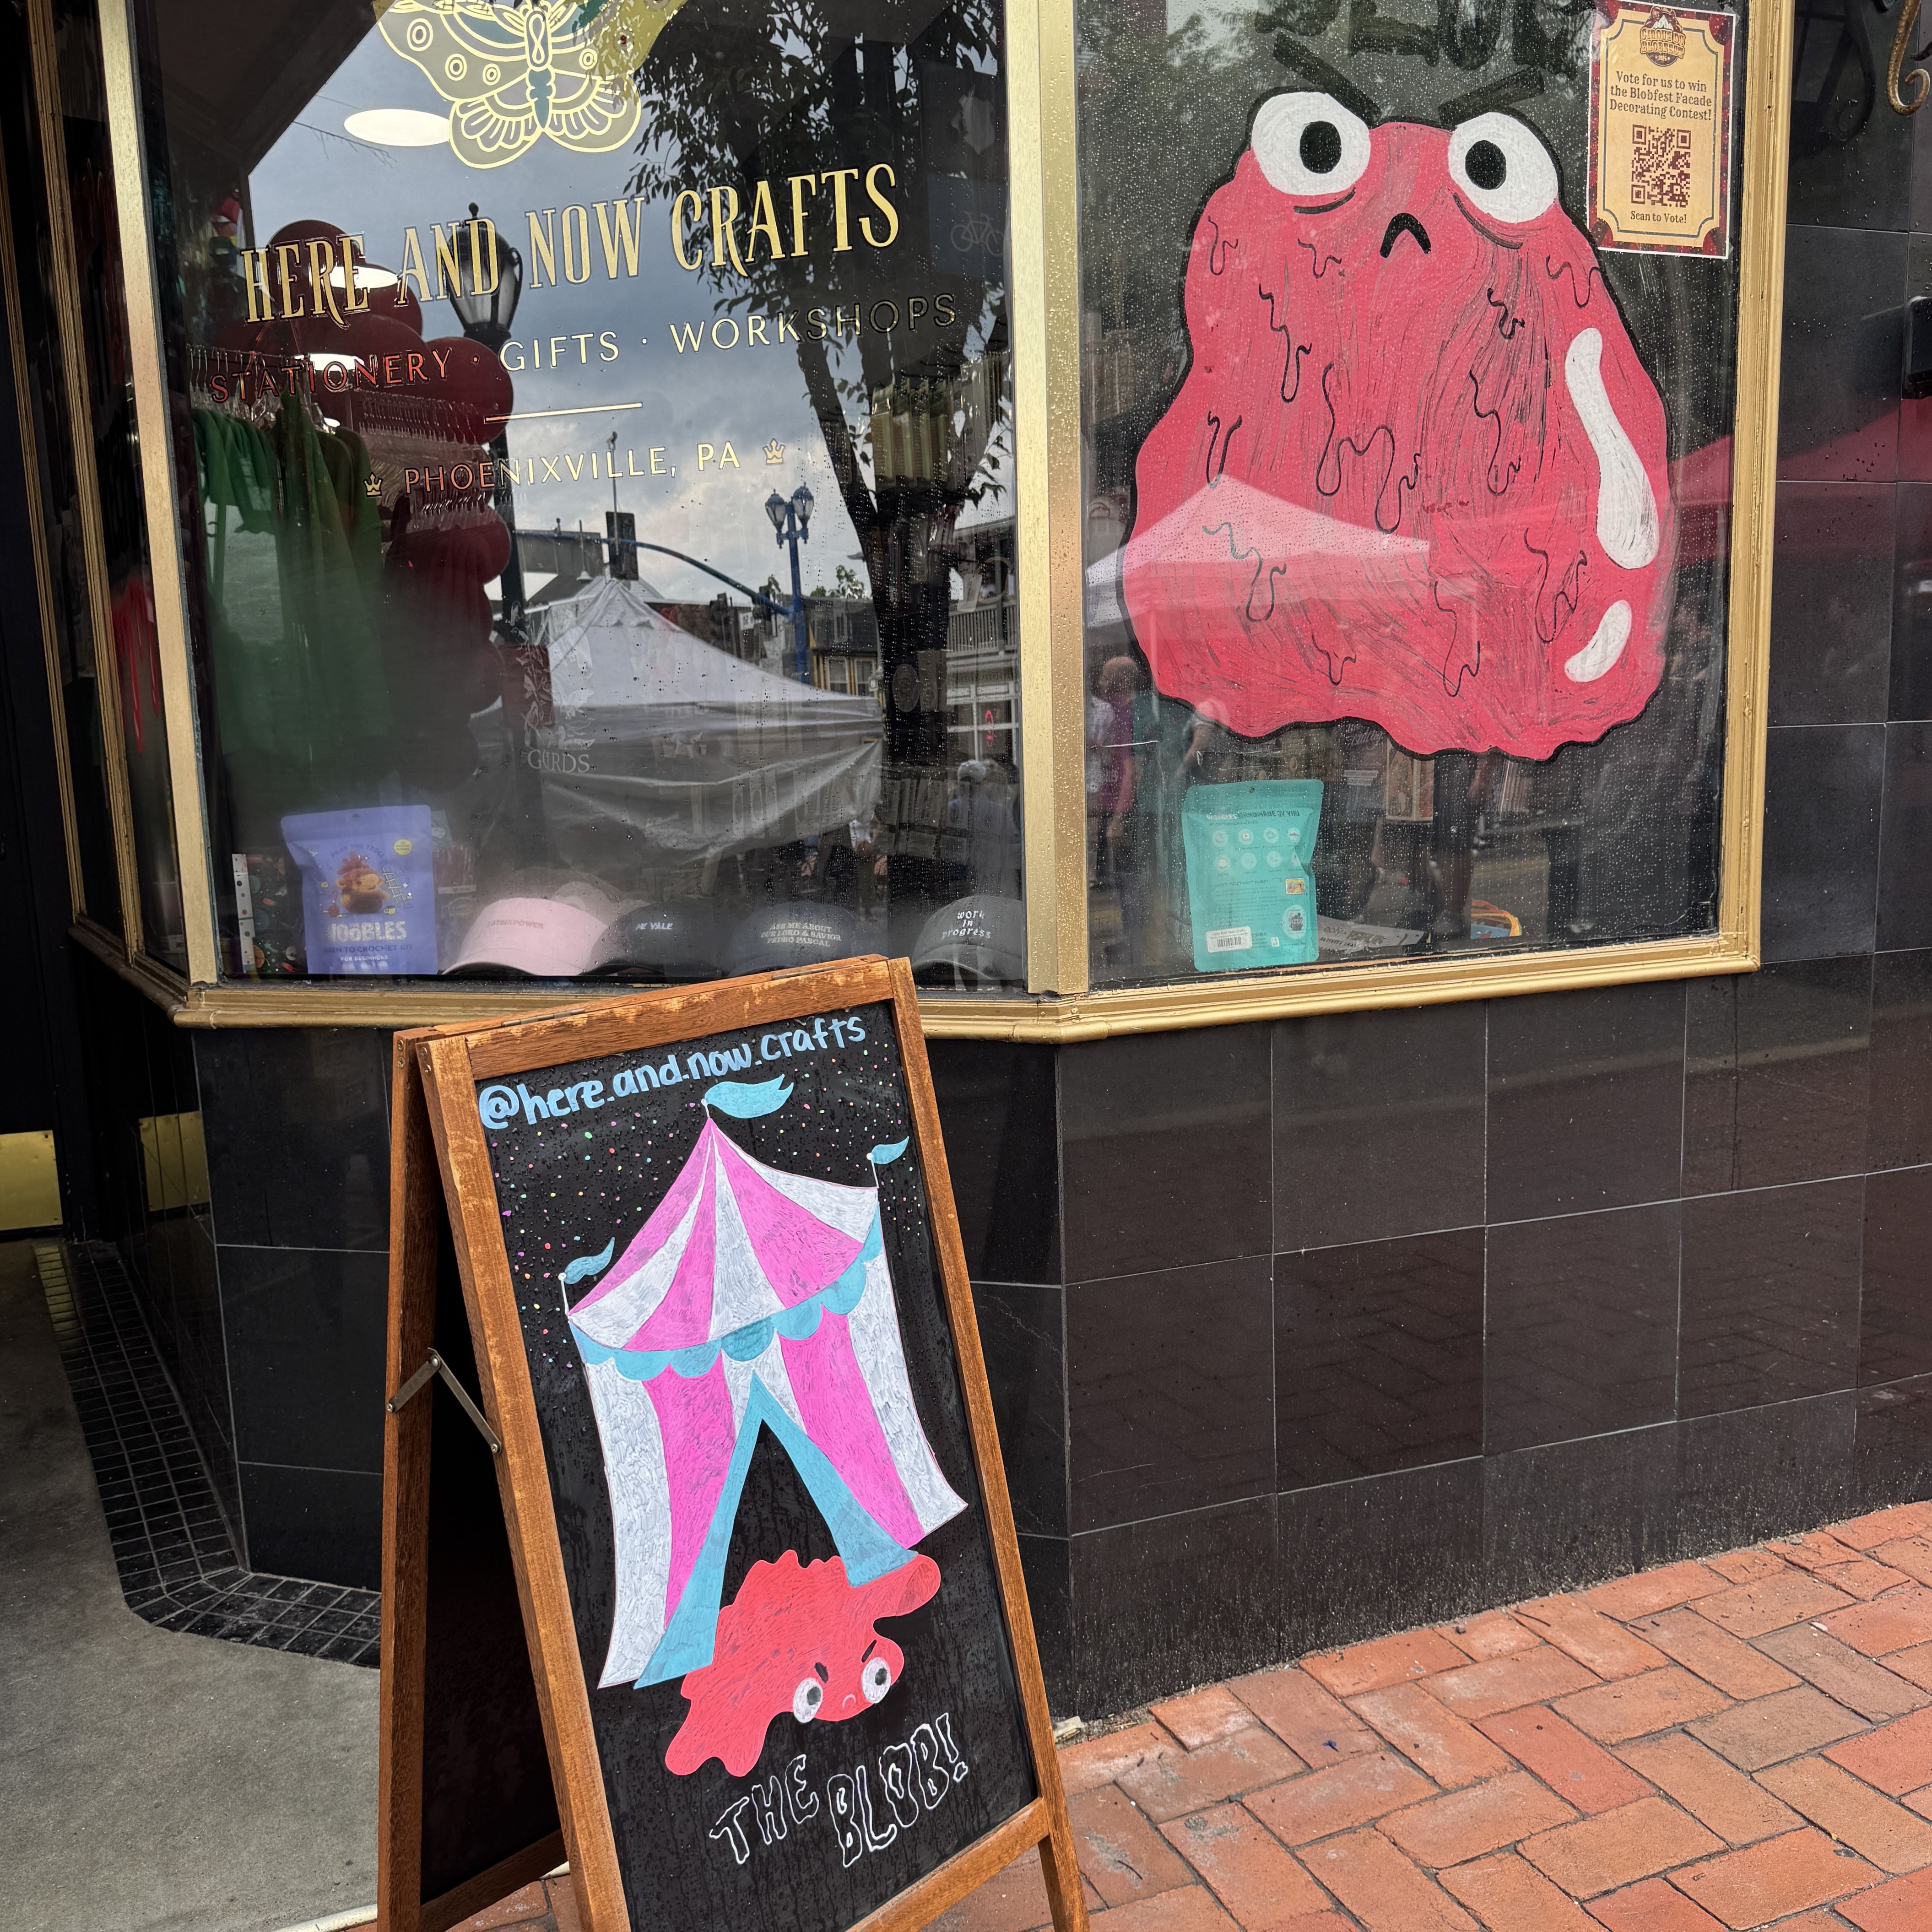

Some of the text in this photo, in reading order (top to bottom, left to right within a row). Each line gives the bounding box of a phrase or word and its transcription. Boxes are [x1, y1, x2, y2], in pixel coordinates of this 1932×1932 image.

[1640, 40, 1685, 58] BLOBFEST
[1616, 71, 1706, 92] Vote for us to win
[1610, 85, 1712, 107] the Blobfest Facade
[1610, 99, 1712, 120] Decorating Contest!
[1630, 211, 1687, 223] Scan to Vote!
[241, 163, 899, 327] HERE AND NOW CRAFTS
[211, 294, 957, 403] STATIONERY GIFTS WORKSHOPS
[404, 441, 741, 494] PHOENIXVILLE, PA
[957, 910, 985, 920] work
[513, 920, 544, 930] POWER
[650, 922, 673, 930] VALE
[802, 922, 832, 933] ABOUT
[810, 931, 842, 942] SAVIOR
[942, 928, 991, 940] progress
[357, 944, 398, 953] CROCHET
[796, 937, 830, 947] PASCAL
[478, 1016, 866, 1130] @here.and.now.crafts
[709, 1712, 970, 1868] THE BLOB!
